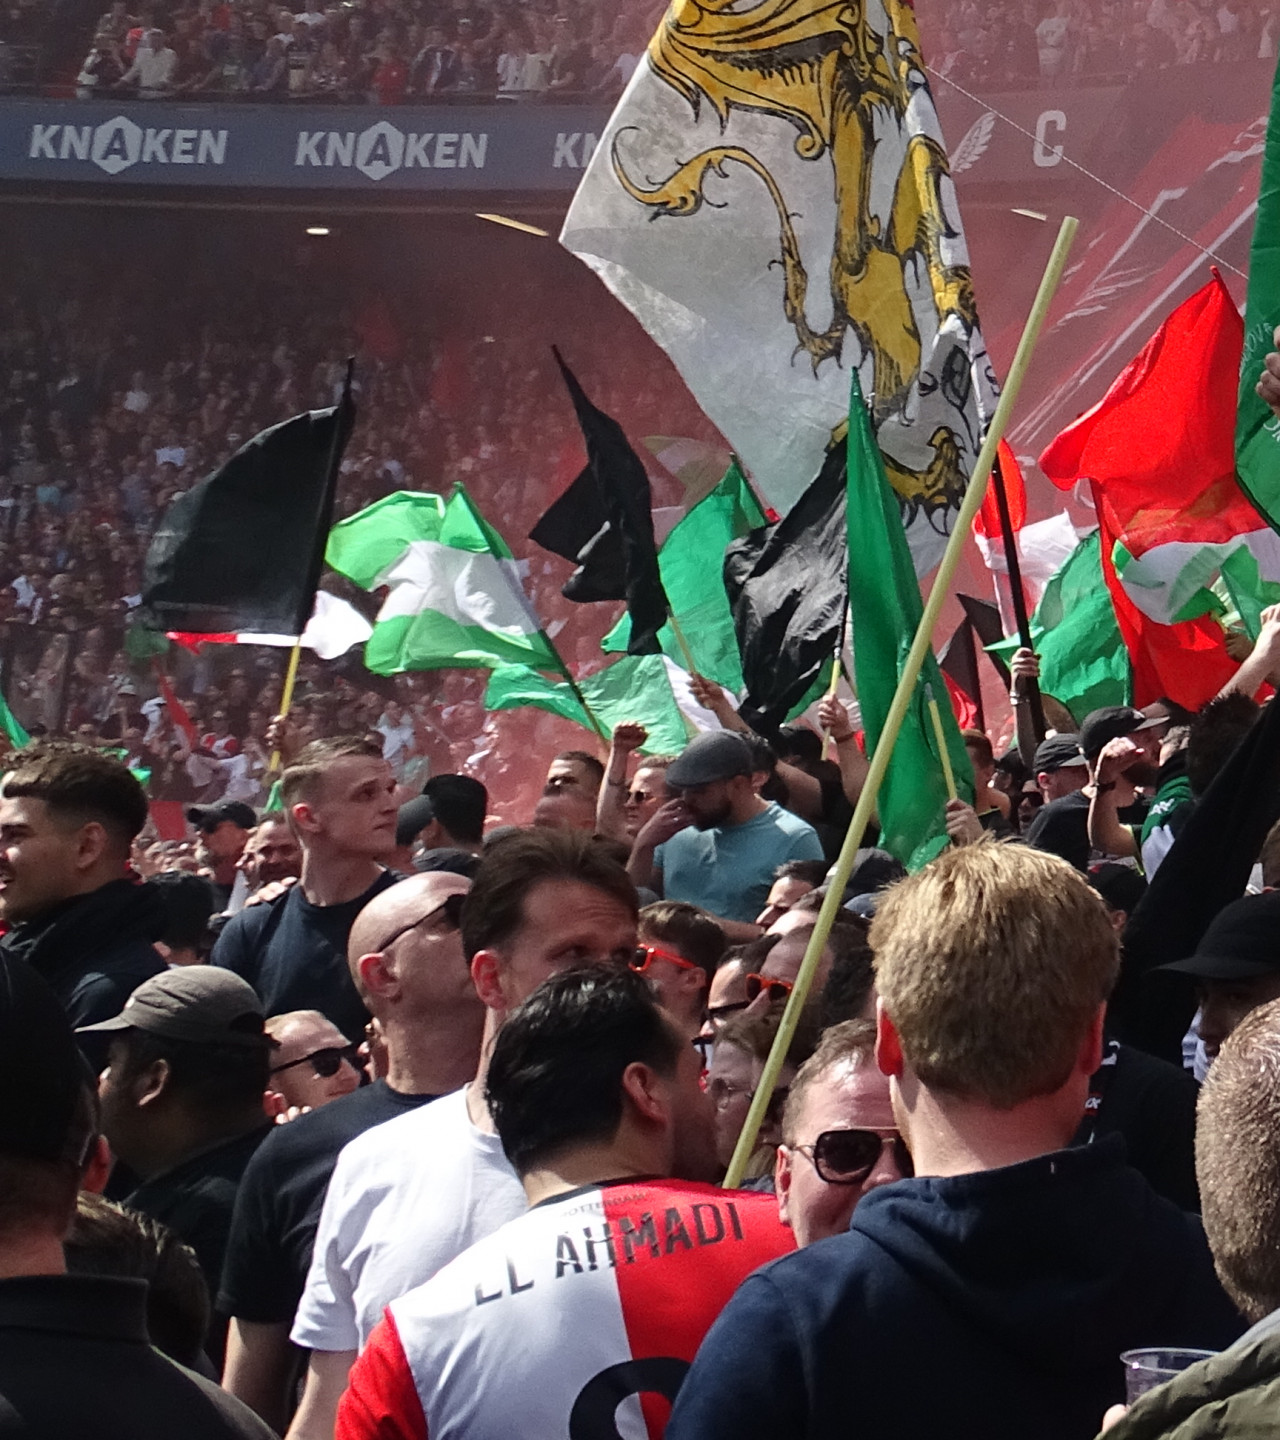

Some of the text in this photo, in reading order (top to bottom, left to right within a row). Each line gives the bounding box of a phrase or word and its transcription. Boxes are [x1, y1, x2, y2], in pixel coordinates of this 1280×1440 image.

[29, 116, 228, 174] KNAKEN
[295, 121, 488, 180] KNAKEN
[561, 1193, 646, 1218] OTTERDAM
[555, 1202, 744, 1279] AHMADI
